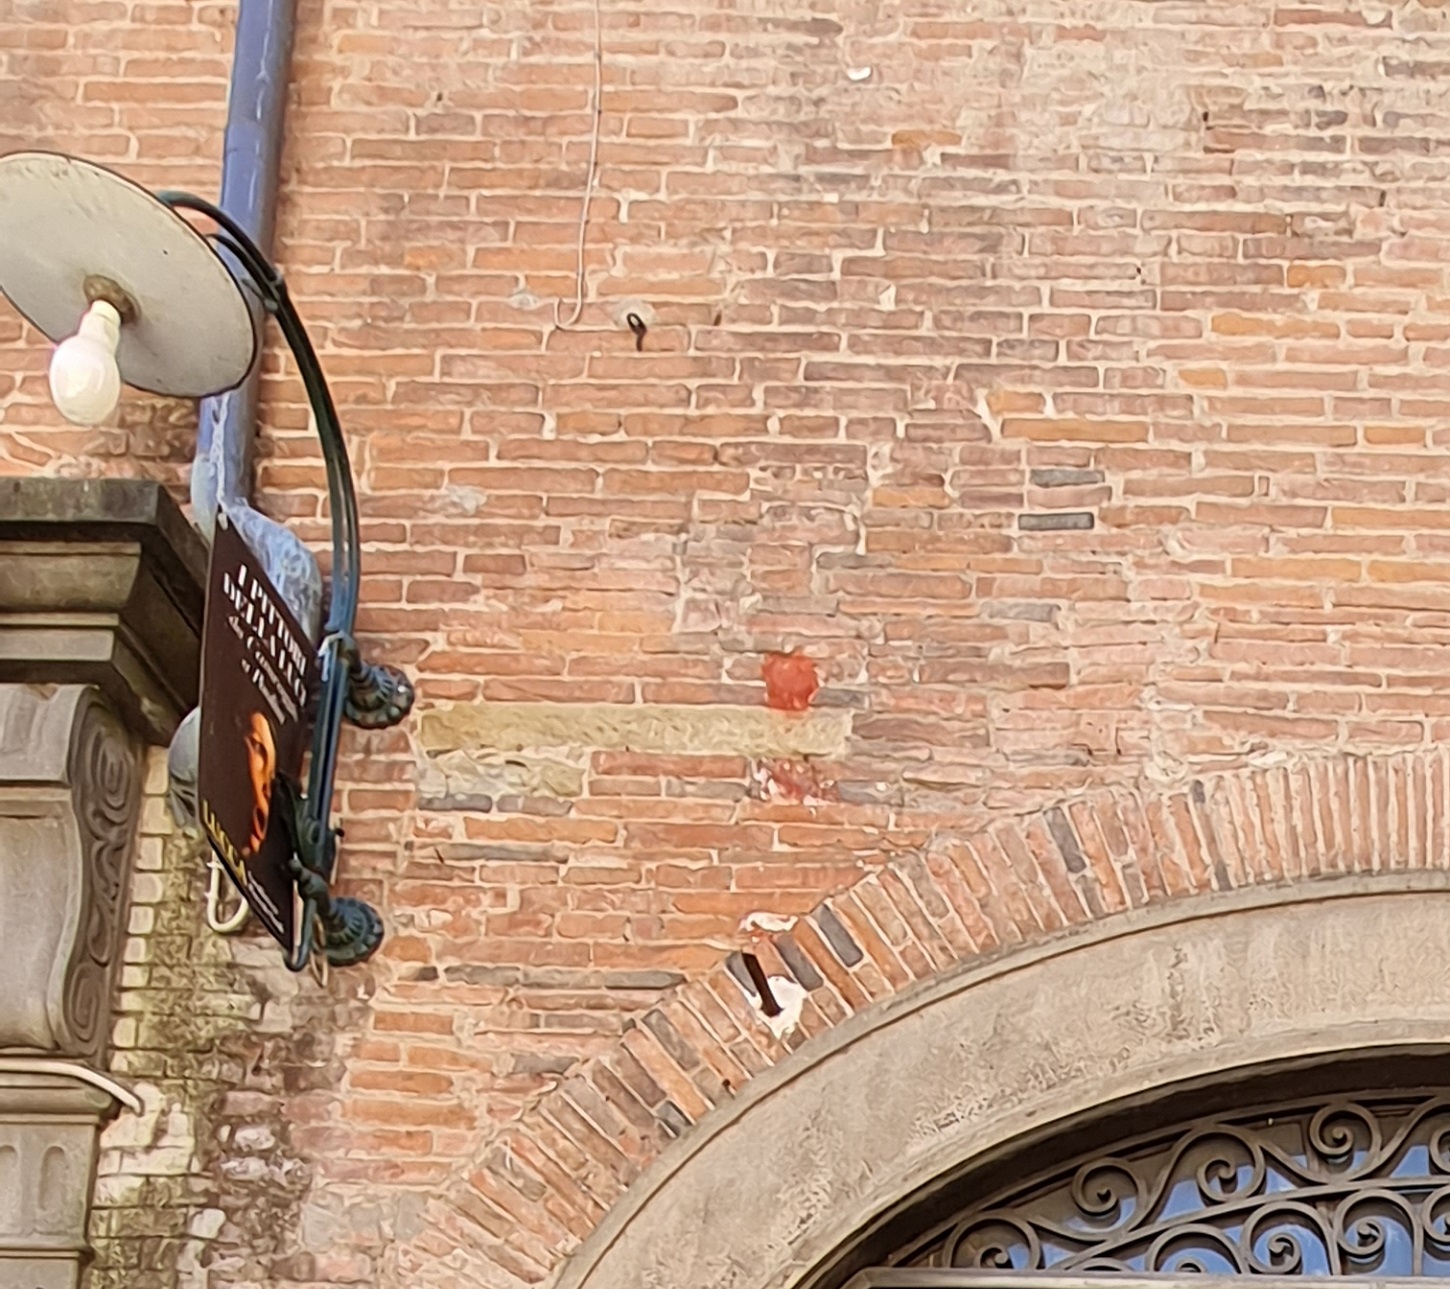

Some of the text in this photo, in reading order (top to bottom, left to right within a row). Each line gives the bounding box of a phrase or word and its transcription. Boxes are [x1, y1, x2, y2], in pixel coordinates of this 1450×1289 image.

[223, 571, 278, 659] DELLA
[237, 563, 248, 588] I
[250, 577, 307, 677] PITTORI
